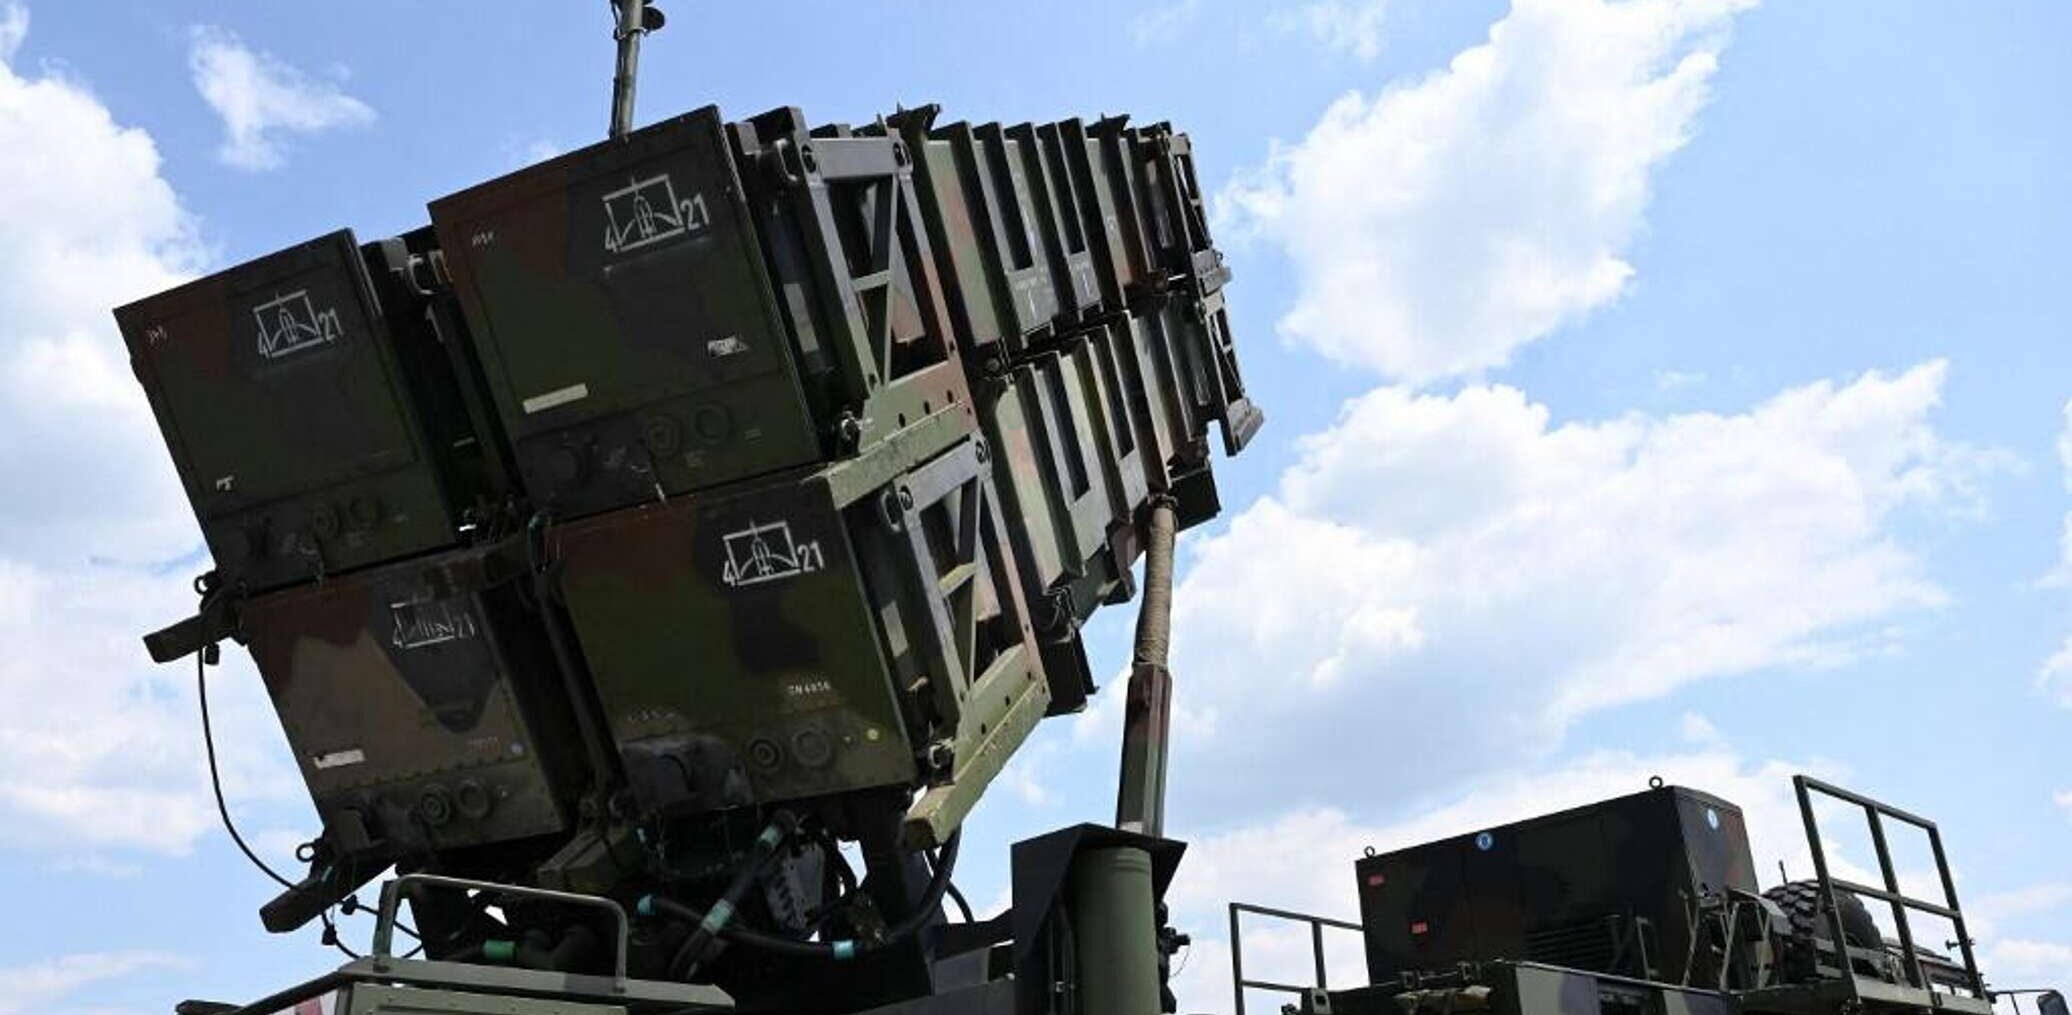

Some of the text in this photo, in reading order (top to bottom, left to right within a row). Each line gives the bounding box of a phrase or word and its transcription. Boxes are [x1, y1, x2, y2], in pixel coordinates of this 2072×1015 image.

[604, 190, 710, 253] 4 21
[256, 307, 344, 360] 4 21
[722, 539, 826, 588] 4 21
